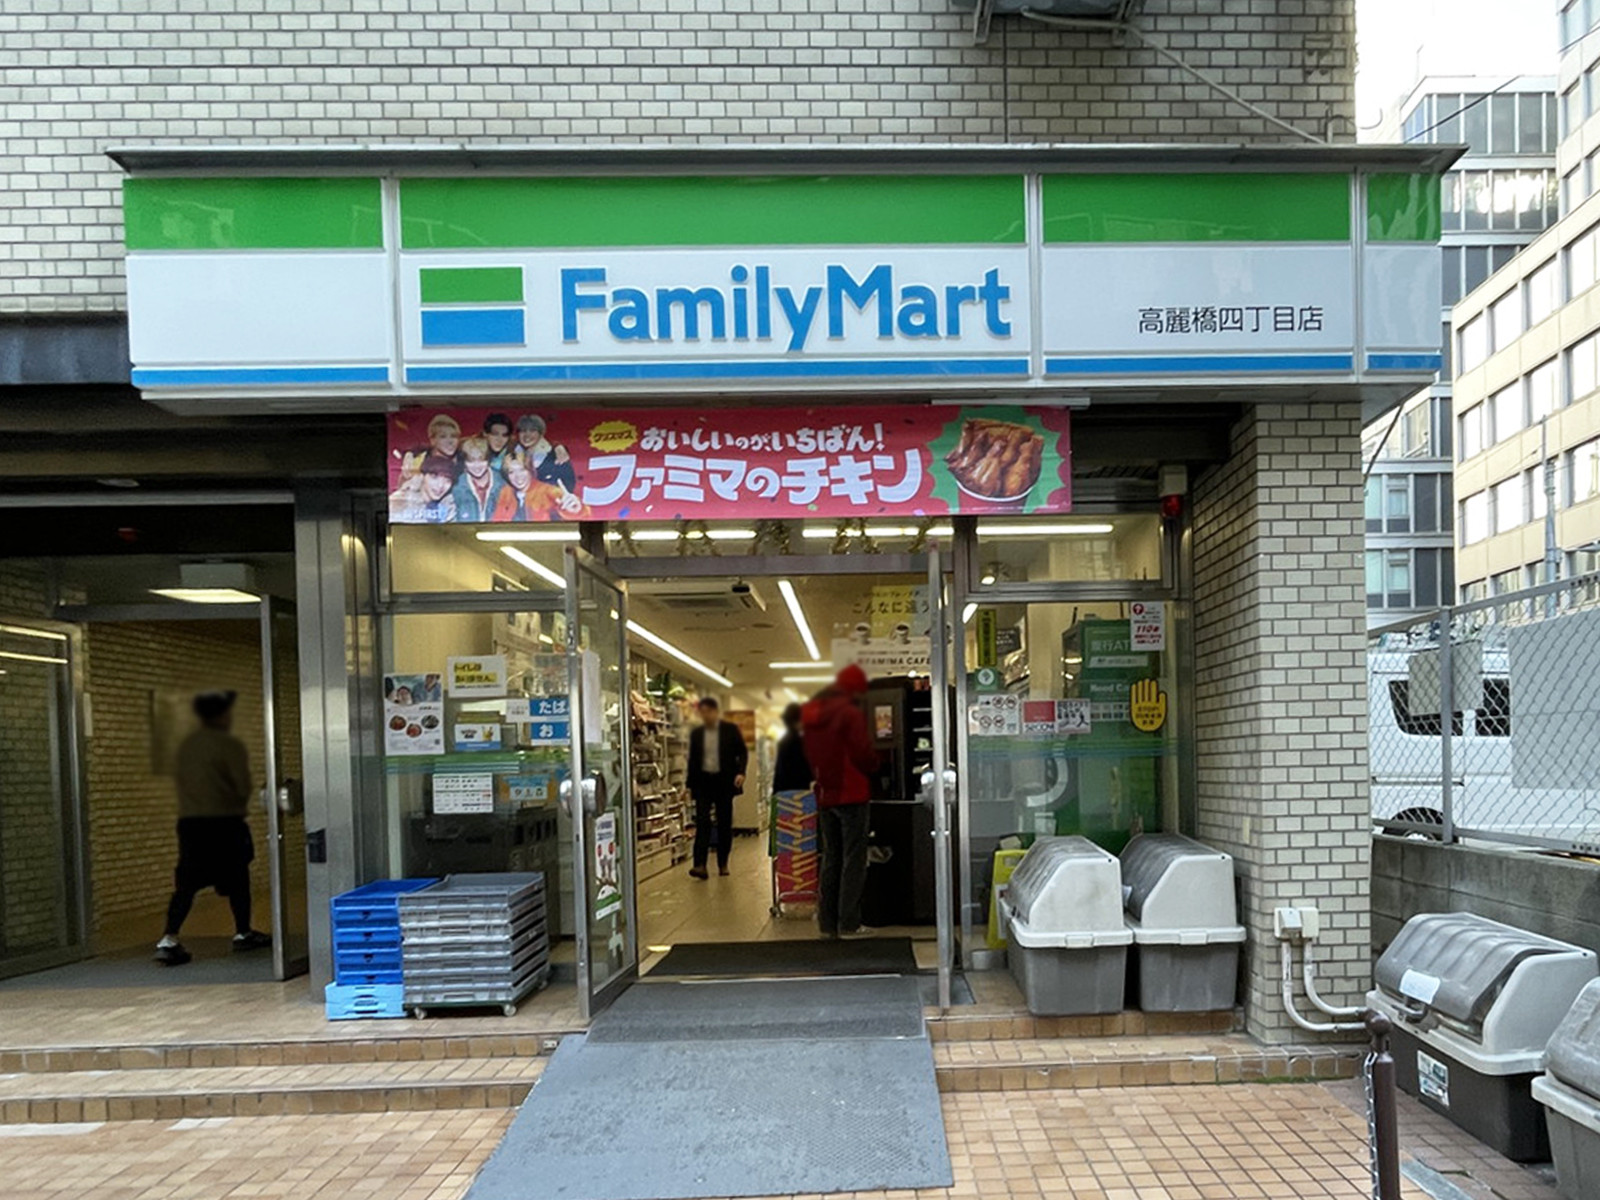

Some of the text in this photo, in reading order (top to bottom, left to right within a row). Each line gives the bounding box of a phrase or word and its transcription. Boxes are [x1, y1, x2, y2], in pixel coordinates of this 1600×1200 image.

[560, 264, 1011, 352] FamilyMart
[1138, 305, 1324, 334] 高麗橋四丁目店
[582, 448, 922, 506] ファミマのチキン
[539, 700, 569, 714] たば
